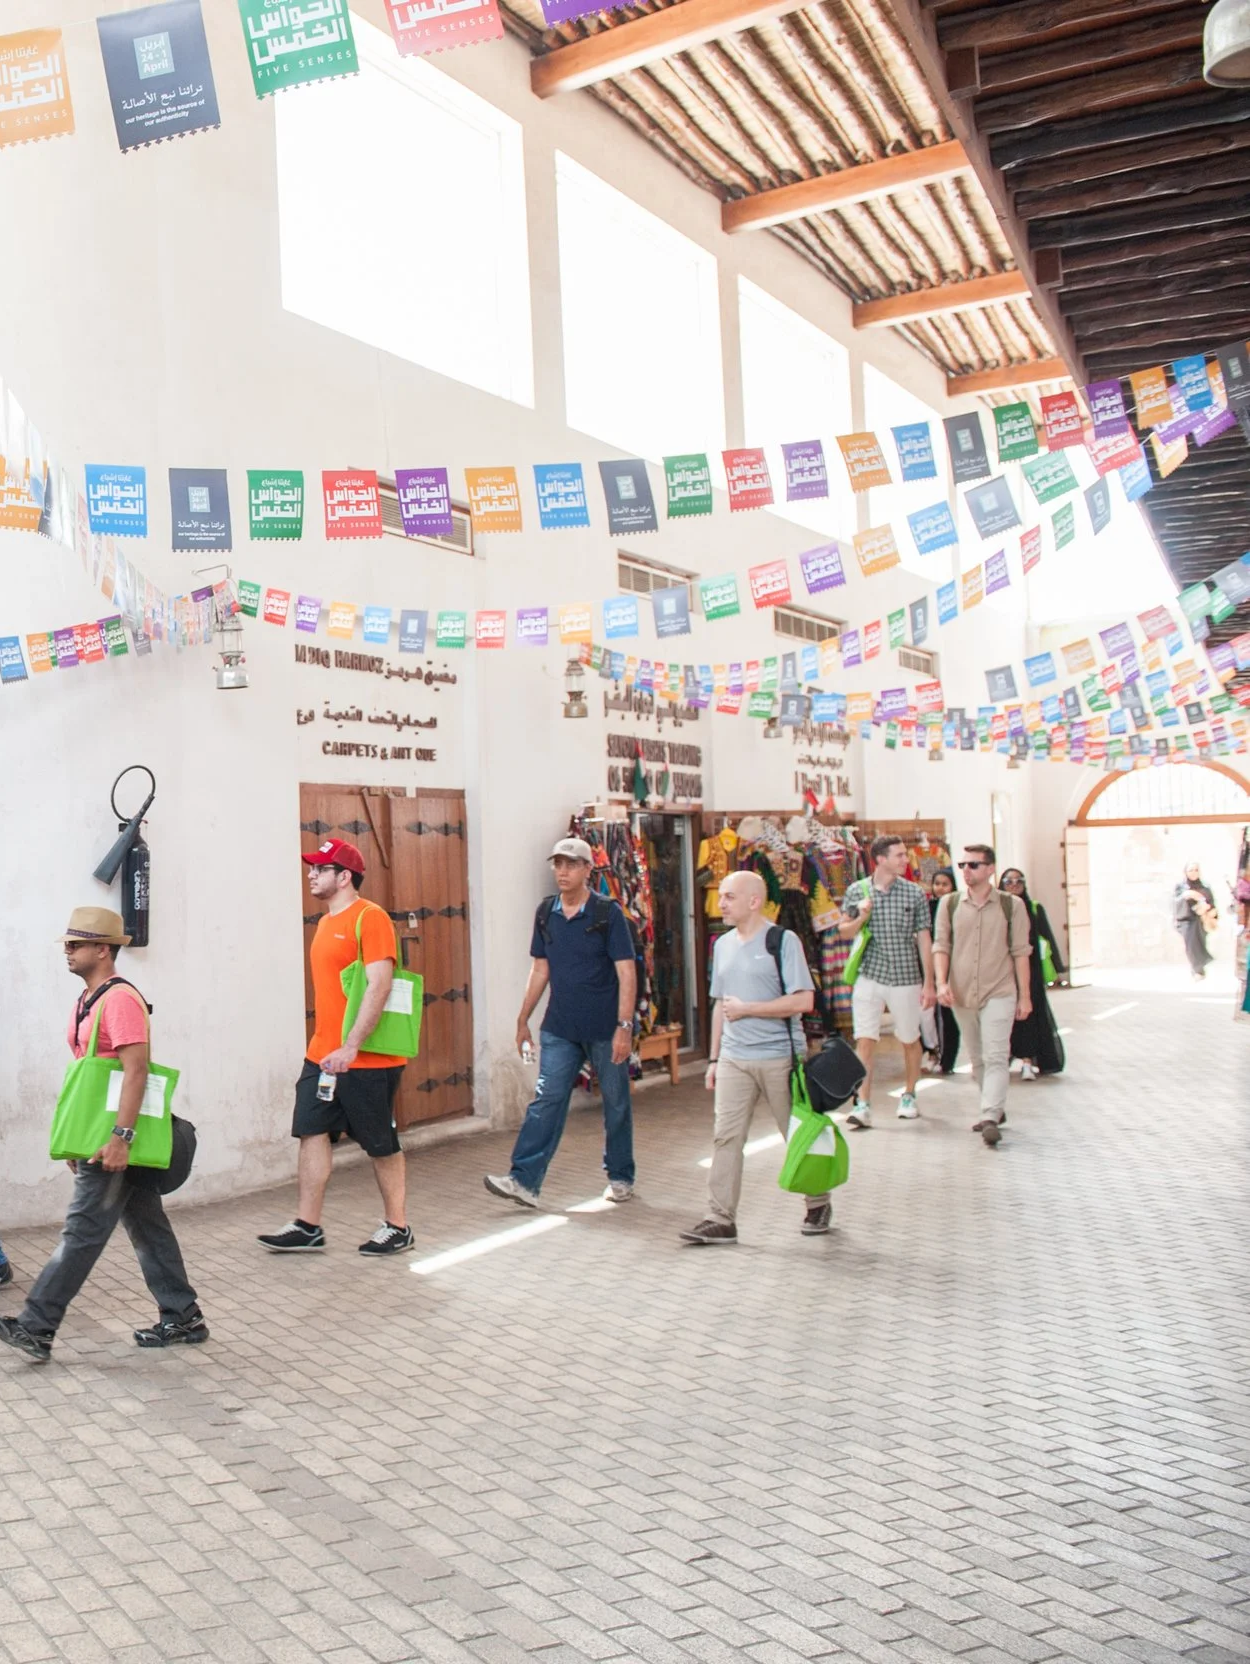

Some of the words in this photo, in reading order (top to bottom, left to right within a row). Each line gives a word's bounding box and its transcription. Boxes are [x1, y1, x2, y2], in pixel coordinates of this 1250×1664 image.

[247, 0, 342, 38] الحواس
[252, 16, 348, 65] الخمس
[141, 52, 154, 62] 24
[144, 59, 169, 73] April
[257, 63, 290, 78] FIVE
[298, 50, 352, 68] SENSES
[160, 91, 176, 106] نبع
[178, 84, 203, 96] تراثنا
[122, 91, 157, 110] الأصالة
[727, 460, 768, 480] الحواس
[90, 482, 143, 500] الحواس
[538, 479, 582, 496] الحواس
[730, 474, 772, 495] الخمس
[252, 487, 301, 504] الحواس
[326, 487, 376, 504] الحواس
[540, 494, 584, 512] الخمس
[90, 500, 143, 515] الخمس
[252, 504, 301, 520] الخمس
[328, 502, 378, 520] الخمس
[322, 740, 378, 758] CARPETS
[380, 747, 388, 760] &
